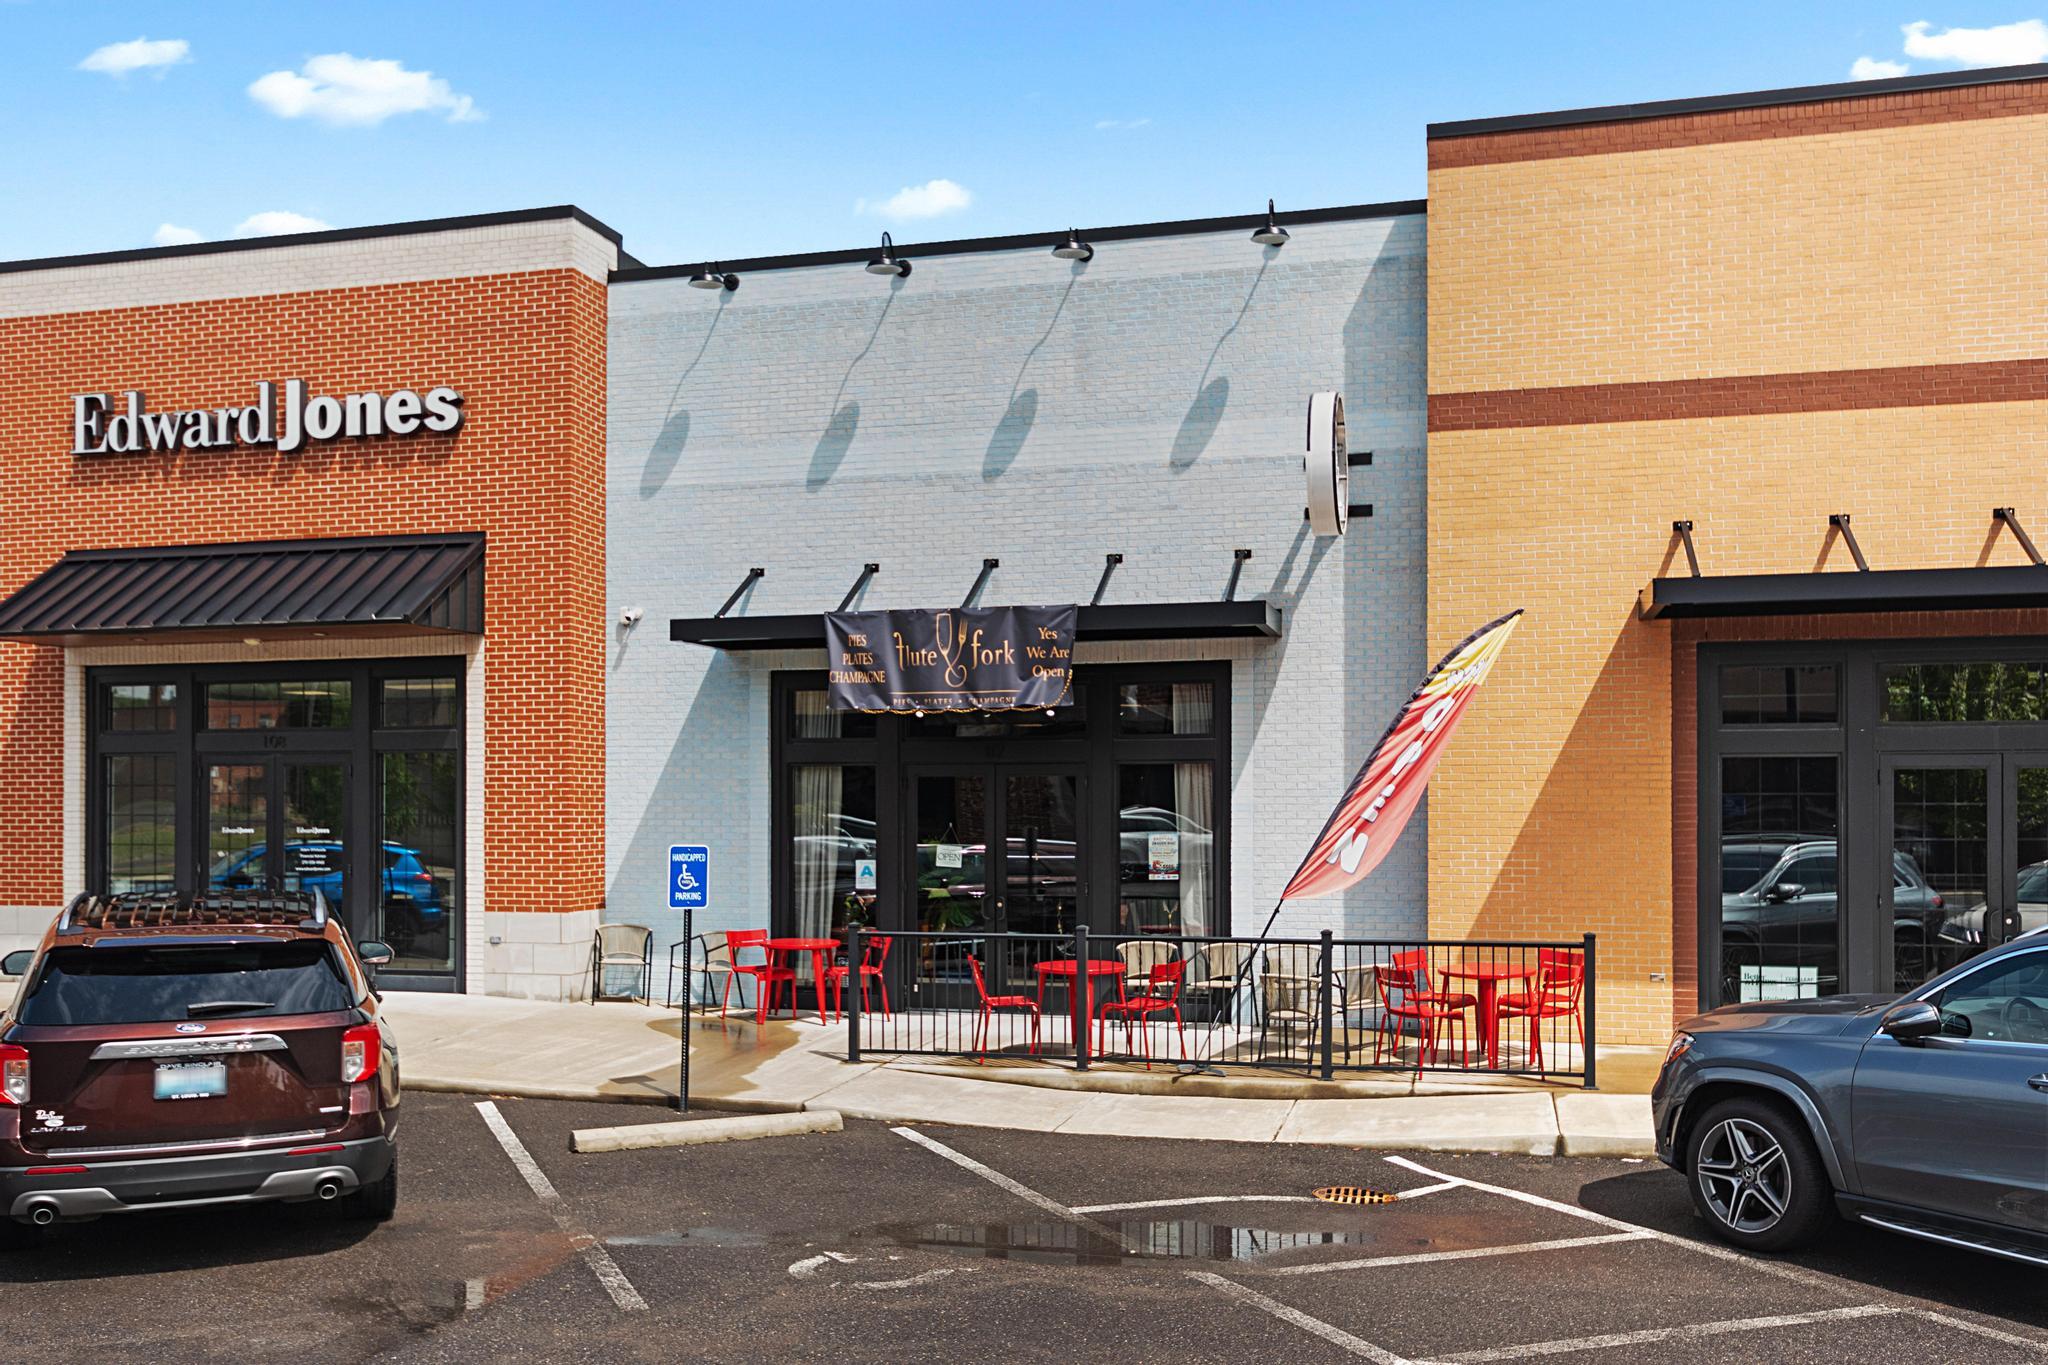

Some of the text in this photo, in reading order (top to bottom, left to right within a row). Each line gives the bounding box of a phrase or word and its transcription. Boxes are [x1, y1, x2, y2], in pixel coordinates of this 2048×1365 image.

[1038, 627, 1058, 640] Yes
[848, 634, 867, 647] PIES
[893, 629, 1016, 671] flute fork
[1026, 645, 1069, 659] We Are
[843, 652, 874, 666] PLATES
[829, 670, 886, 684] CHAMPAGNE
[1032, 664, 1065, 682] Open
[672, 853, 706, 862] HANDICAPPED
[937, 852, 960, 862] OPEN
[860, 865, 874, 877] A
[675, 891, 702, 901] PARKING
